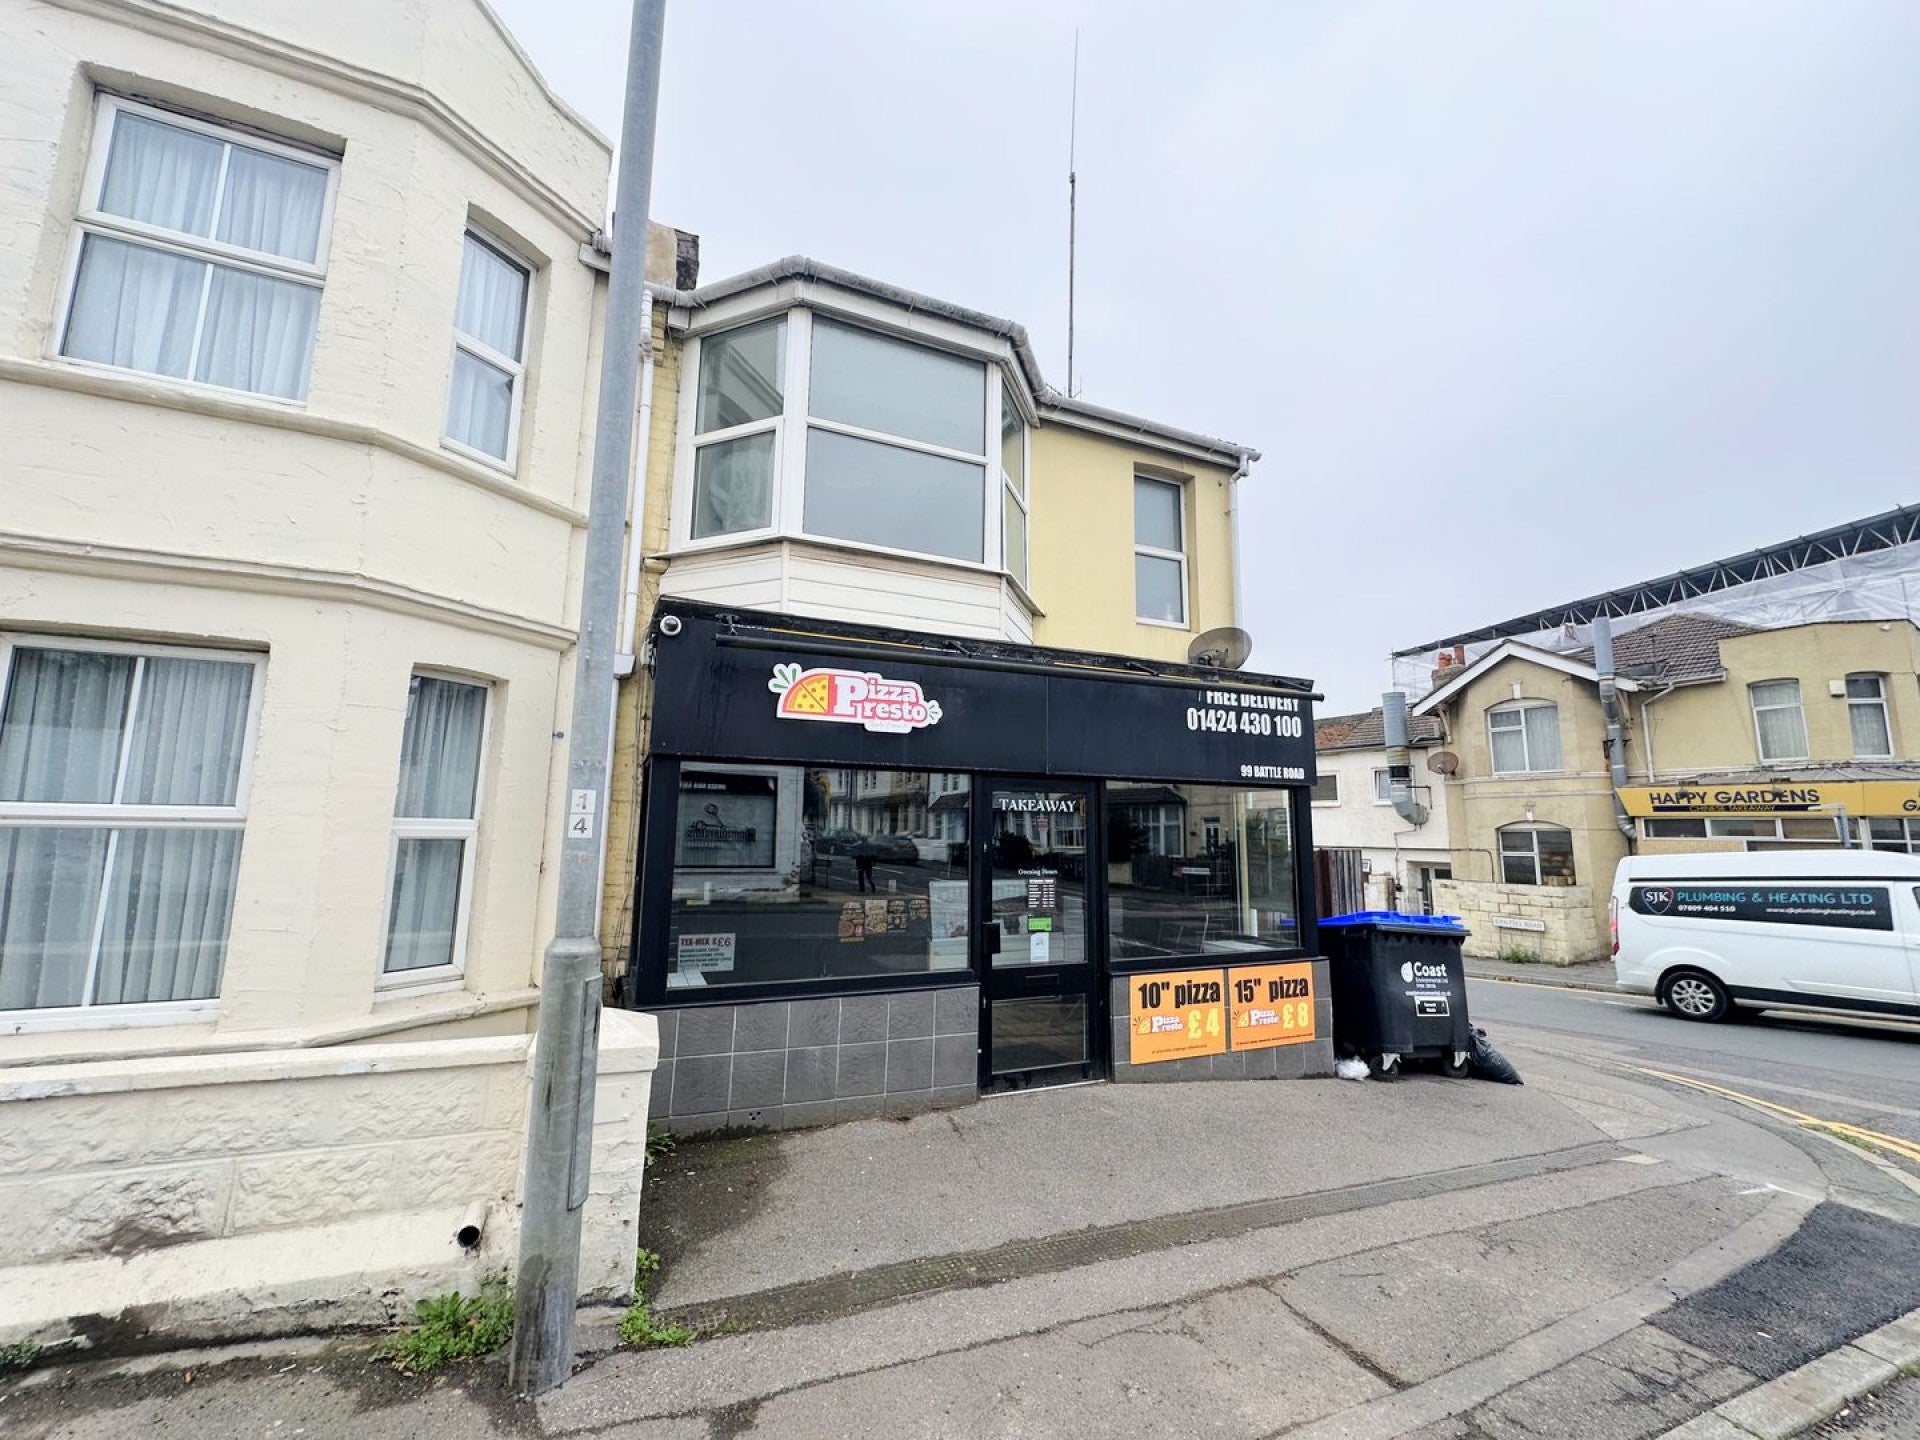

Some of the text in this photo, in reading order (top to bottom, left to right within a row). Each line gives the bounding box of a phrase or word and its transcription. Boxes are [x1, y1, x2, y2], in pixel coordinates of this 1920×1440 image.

[833, 675, 917, 708] Pizza
[1206, 690, 1299, 712] FREE DELIVERY
[1186, 707, 1302, 738] 01424 430 100
[1240, 764, 1305, 780] 99 BATTLE ROAD
[1714, 788, 1820, 804] GARDENS
[998, 798, 1077, 813] TAKEAWAY
[572, 817, 588, 834] 4
[1645, 891, 1669, 904] SJK
[1677, 891, 1873, 905] PLUMBING & HEATING LTD
[1414, 961, 1447, 977] Coast
[1138, 979, 1221, 1009] 10" pizza
[1234, 976, 1309, 1003] 15" pizza
